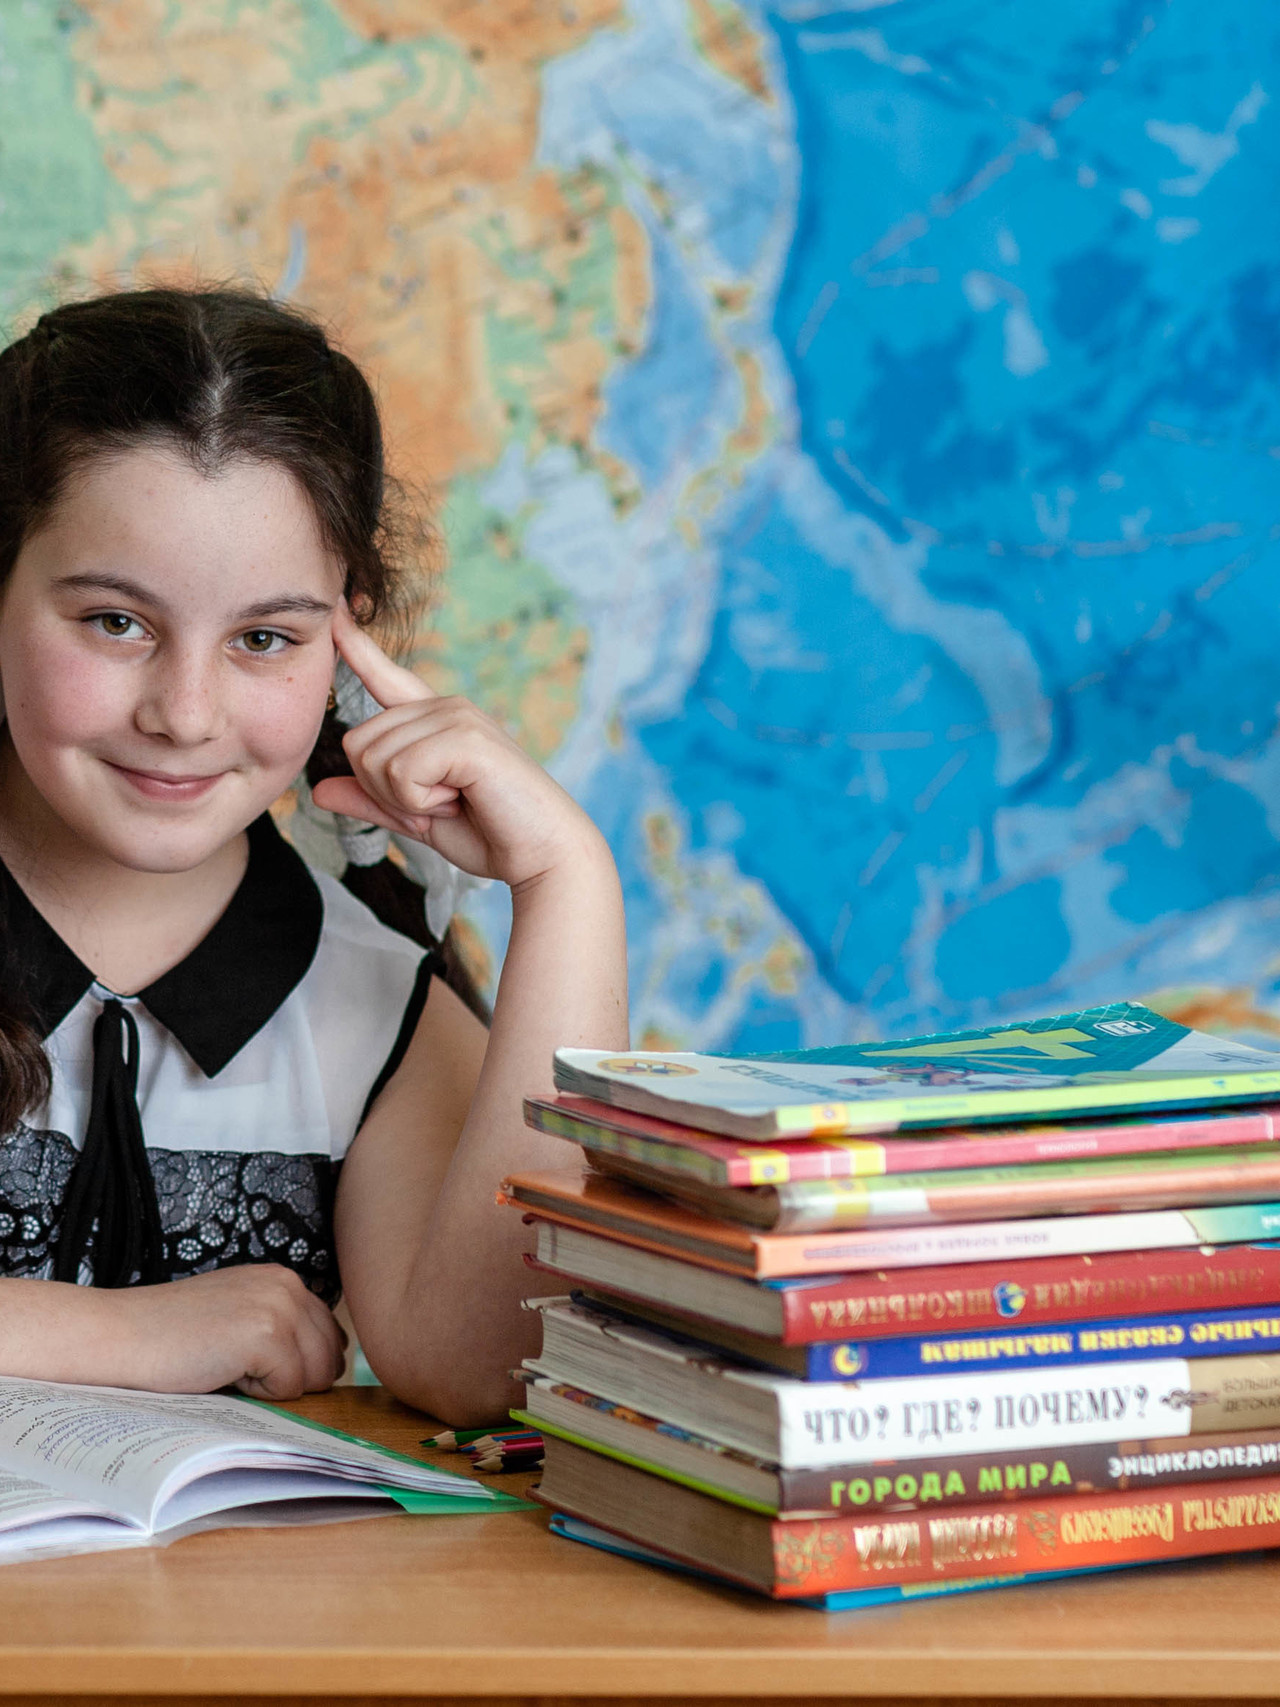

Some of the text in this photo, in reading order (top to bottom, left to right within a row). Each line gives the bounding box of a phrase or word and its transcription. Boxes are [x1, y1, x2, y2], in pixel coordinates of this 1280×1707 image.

[810, 1288, 993, 1329] ШКОЛЬНИКА
[920, 1331, 1073, 1363] малышам
[1079, 1325, 1185, 1352] сказки
[804, 1386, 1150, 1445] ЧТО? ГДЕ? ПОЧЕМУ?
[830, 1460, 1073, 1507] ГОРОДА МИРА
